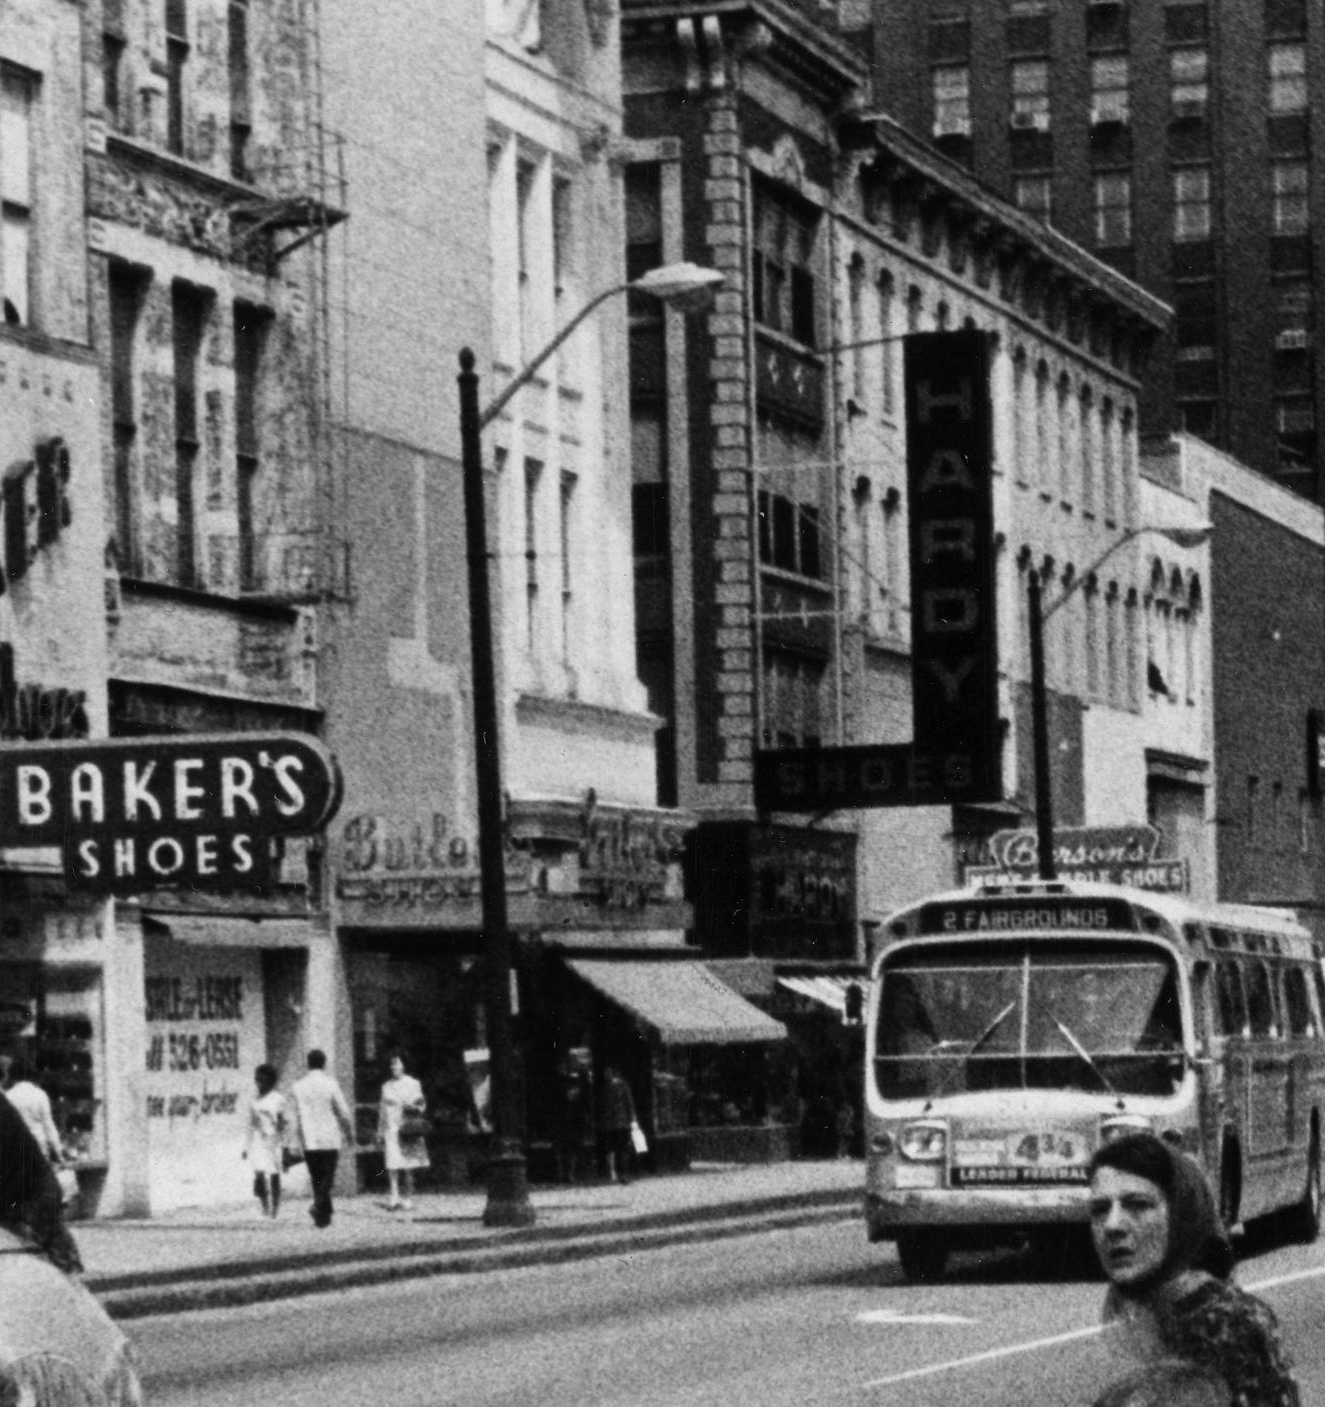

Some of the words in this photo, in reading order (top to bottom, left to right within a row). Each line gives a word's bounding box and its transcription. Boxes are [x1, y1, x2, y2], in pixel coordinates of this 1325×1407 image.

[915, 377, 980, 702] HARDY
[17, 749, 305, 826] BAKER'S
[777, 752, 973, 797] SHOES
[79, 834, 254, 878] SHOES
[943, 910, 957, 930] 2
[965, 908, 1109, 931] FAIRGROUNDS
